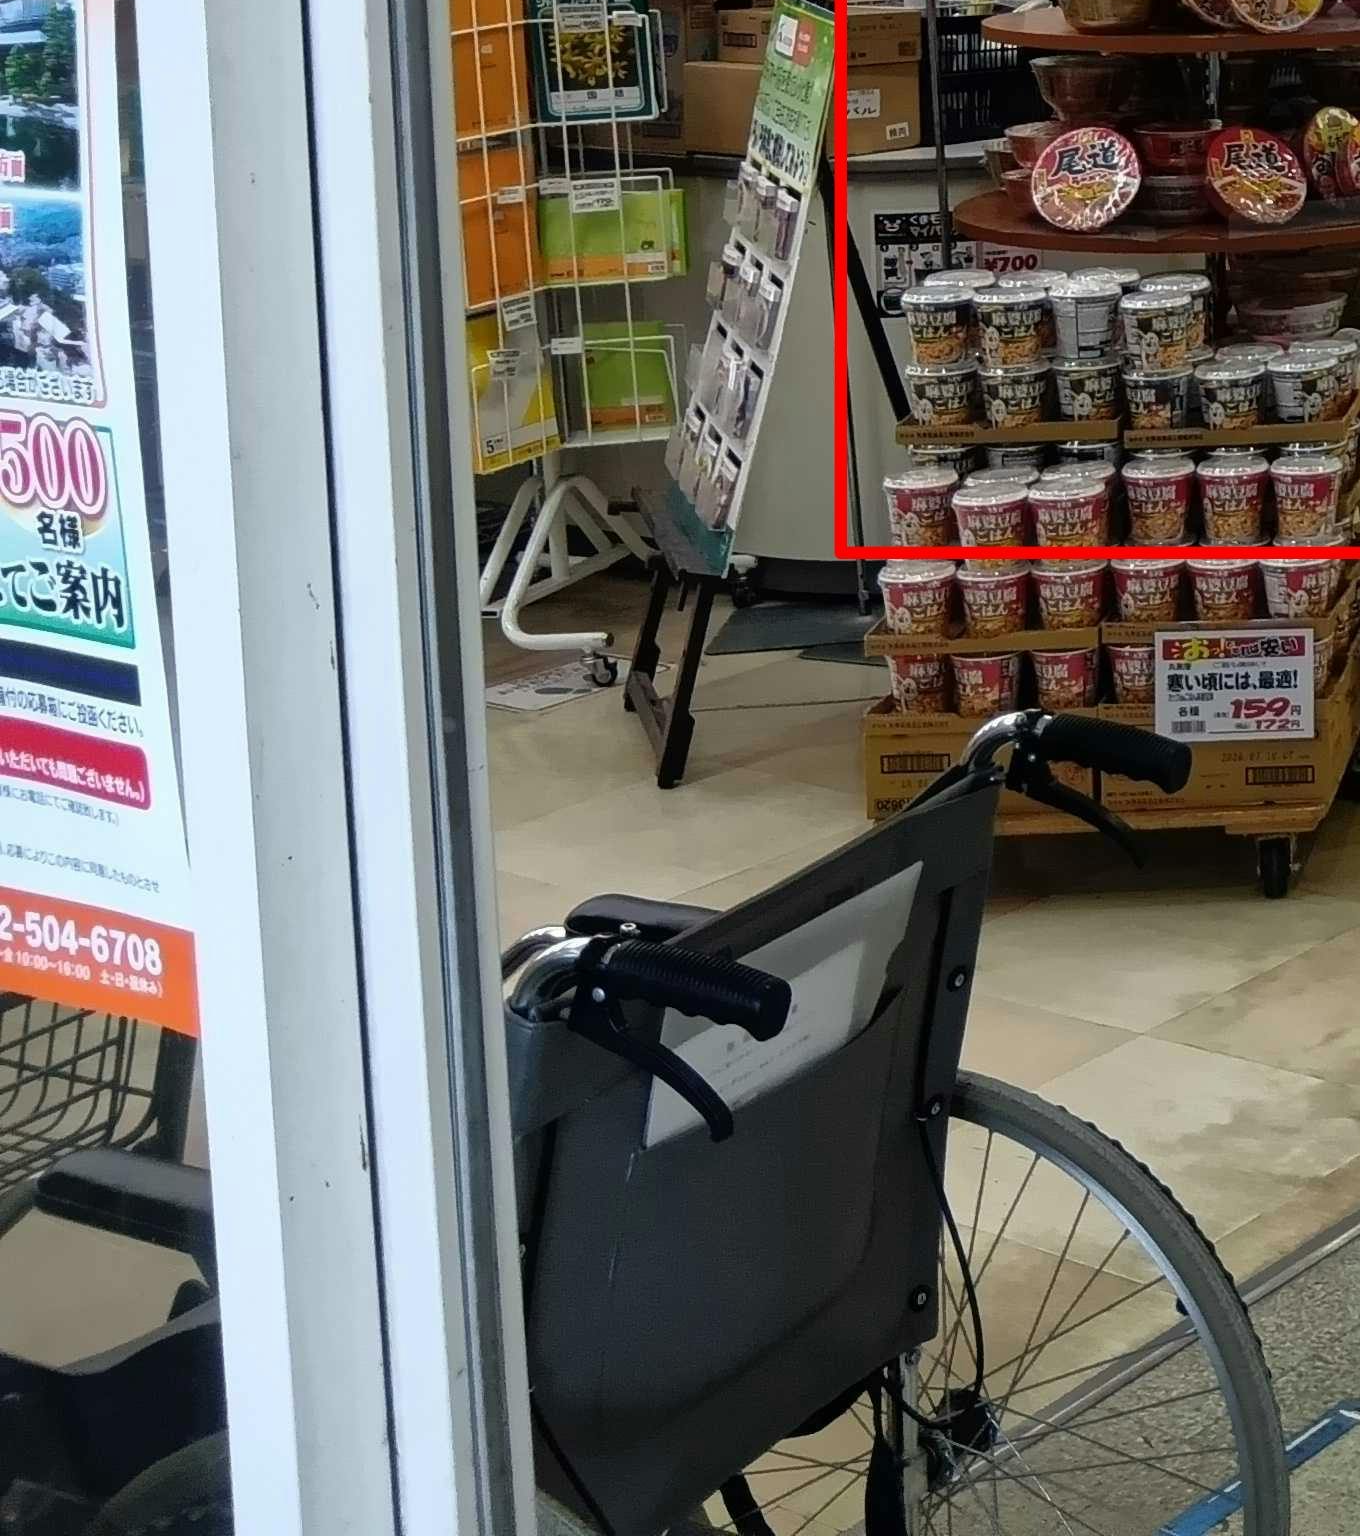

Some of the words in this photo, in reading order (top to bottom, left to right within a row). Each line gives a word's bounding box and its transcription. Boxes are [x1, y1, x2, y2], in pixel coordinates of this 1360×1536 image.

[1055, 140, 1119, 176] 尾道
[1223, 143, 1288, 176] 尾道
[37, 513, 82, 549] 名様
[1168, 669, 1298, 691] 寒い頃には、最適!
[1230, 697, 1291, 719] 159
[1255, 718, 1290, 730] 172
